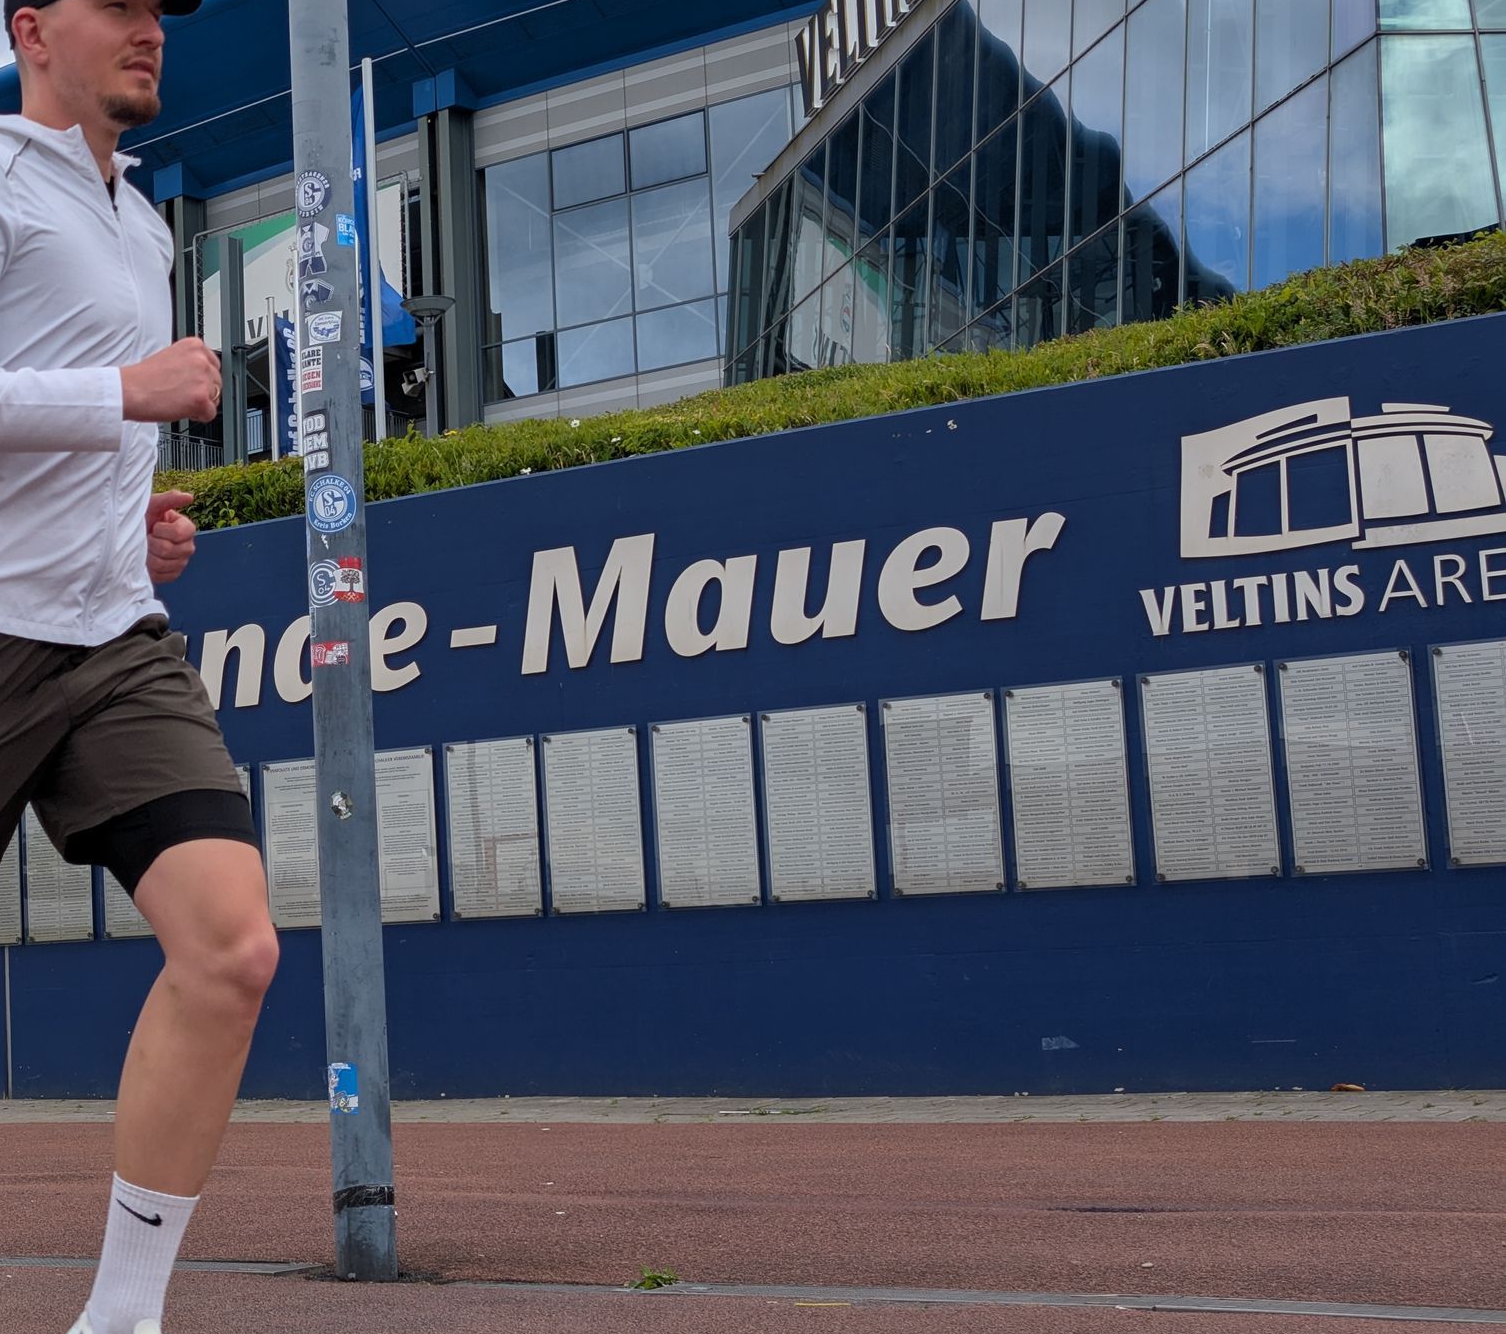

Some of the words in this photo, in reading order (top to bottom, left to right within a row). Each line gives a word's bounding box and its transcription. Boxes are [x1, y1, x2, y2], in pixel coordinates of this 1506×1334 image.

[338, 223, 355, 234] BLA
[313, 478, 345, 494] SCHALKE
[324, 506, 337, 517] 04
[1139, 564, 1366, 636] VELTINS
[1378, 547, 1506, 612] ARE
